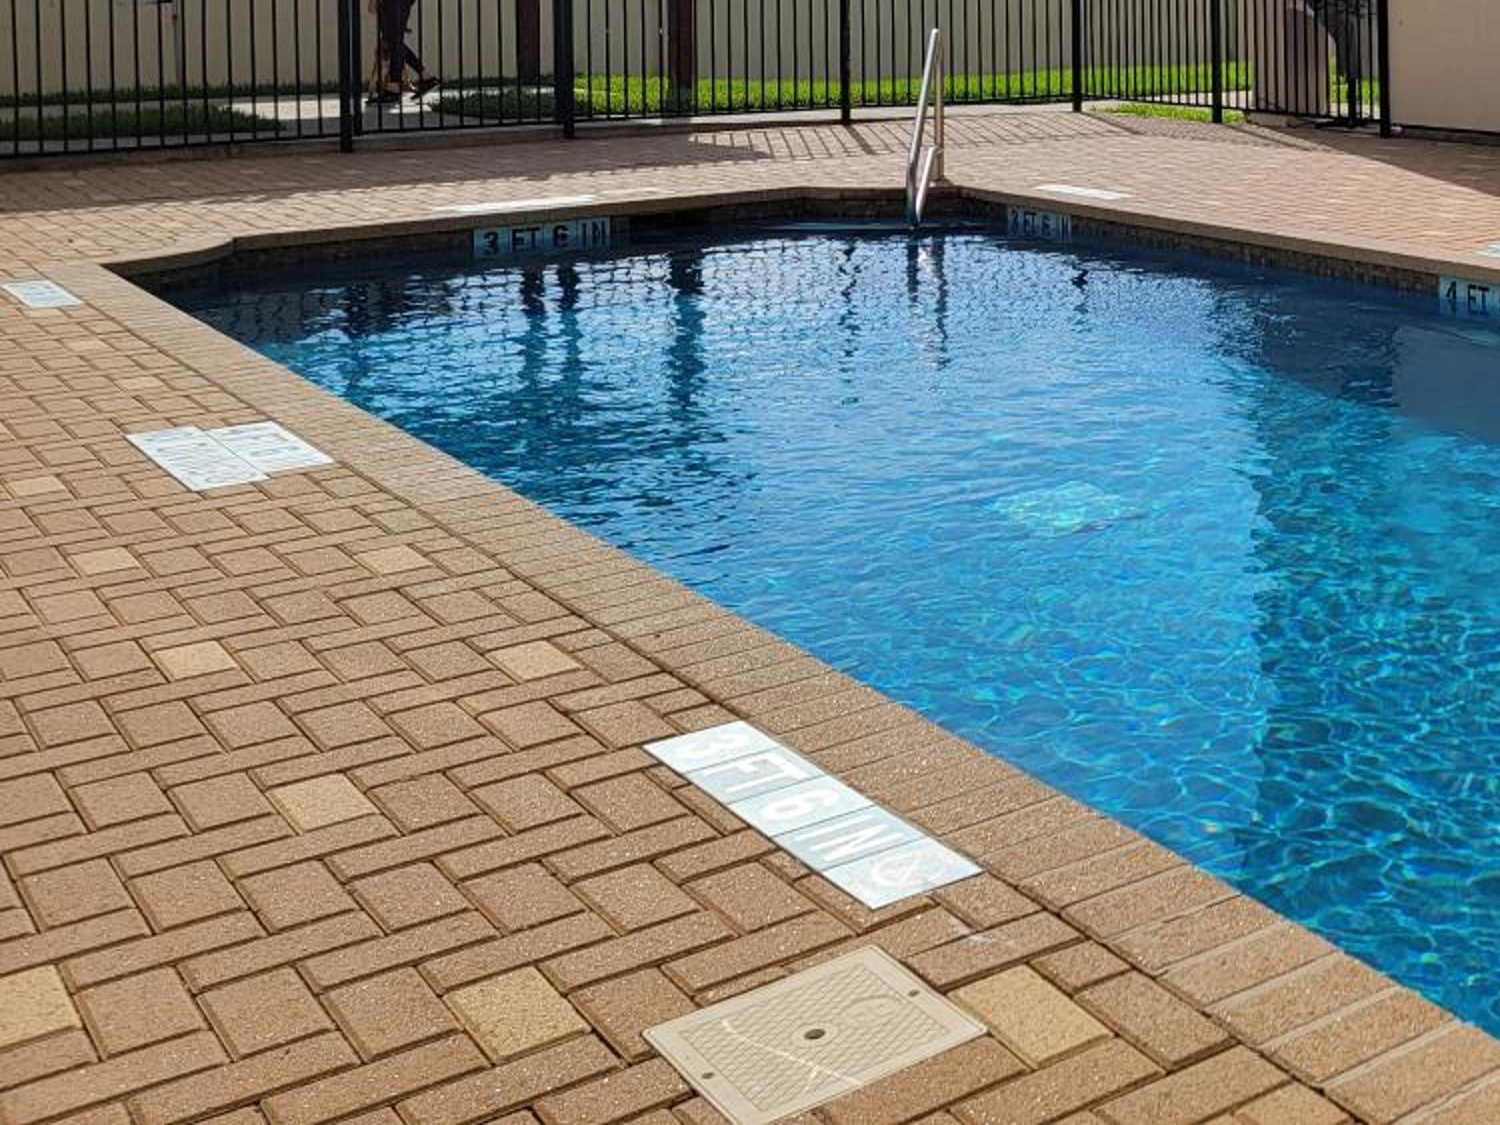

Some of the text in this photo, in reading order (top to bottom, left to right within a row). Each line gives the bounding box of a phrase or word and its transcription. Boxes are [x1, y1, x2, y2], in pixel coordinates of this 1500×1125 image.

[483, 220, 606, 255] 3 FT 6 IN
[673, 728, 904, 861] 3 FT 6 IN
